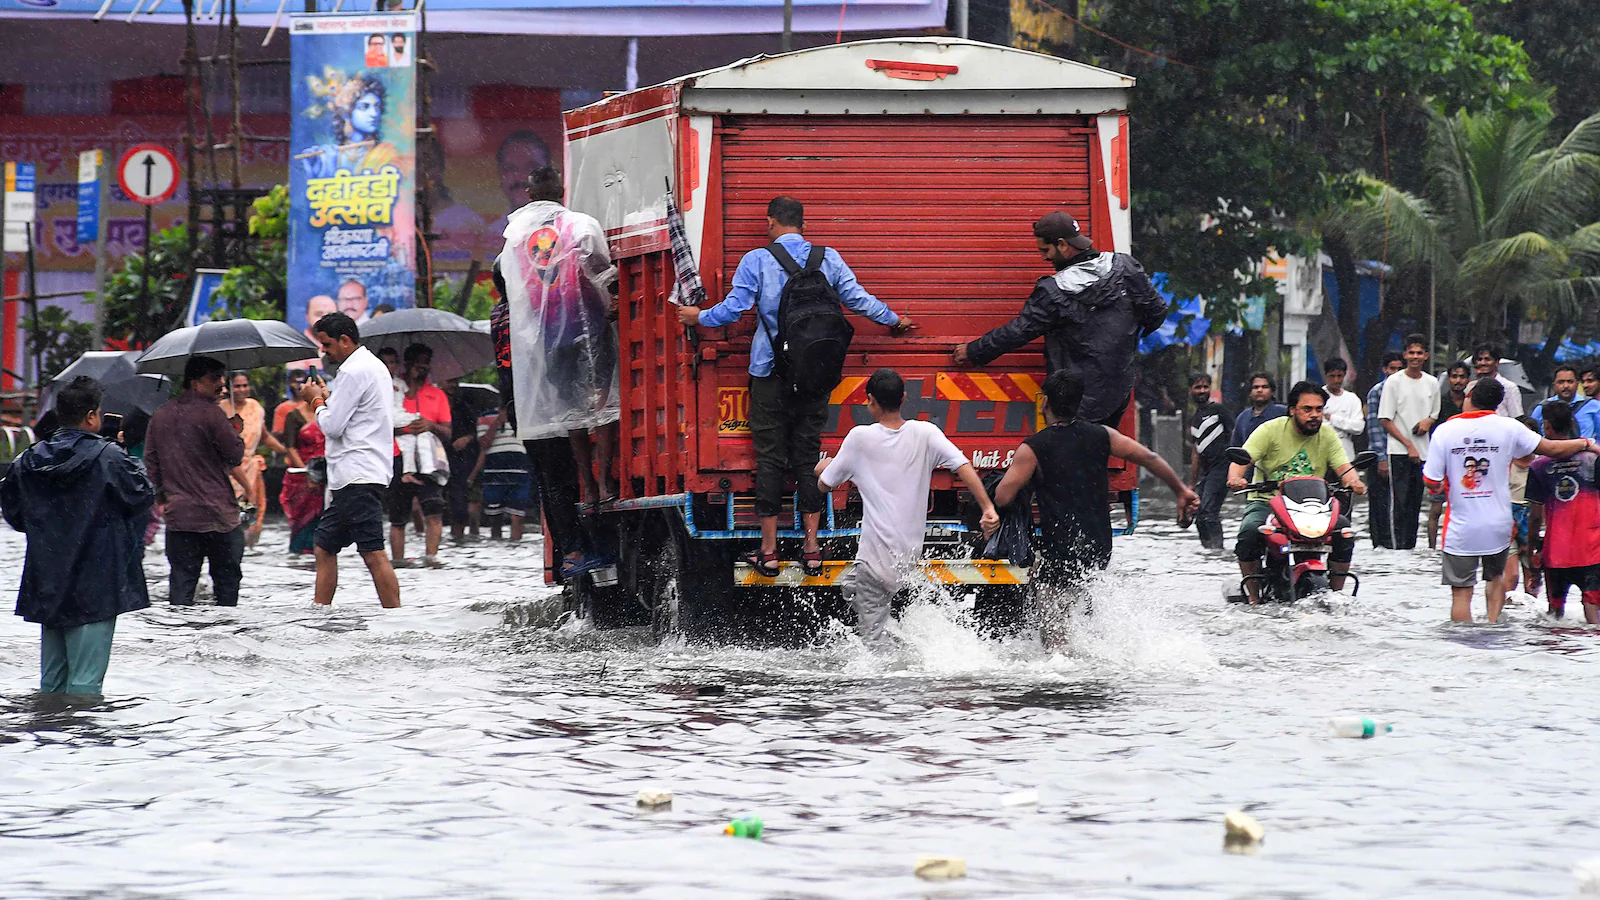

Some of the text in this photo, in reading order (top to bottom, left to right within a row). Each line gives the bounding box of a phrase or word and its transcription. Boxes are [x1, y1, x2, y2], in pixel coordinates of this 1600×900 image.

[306, 165, 400, 200] दहीहंडी
[309, 198, 394, 227] उत्सव
[719, 390, 750, 421] STO
[972, 449, 1001, 468] Wait
